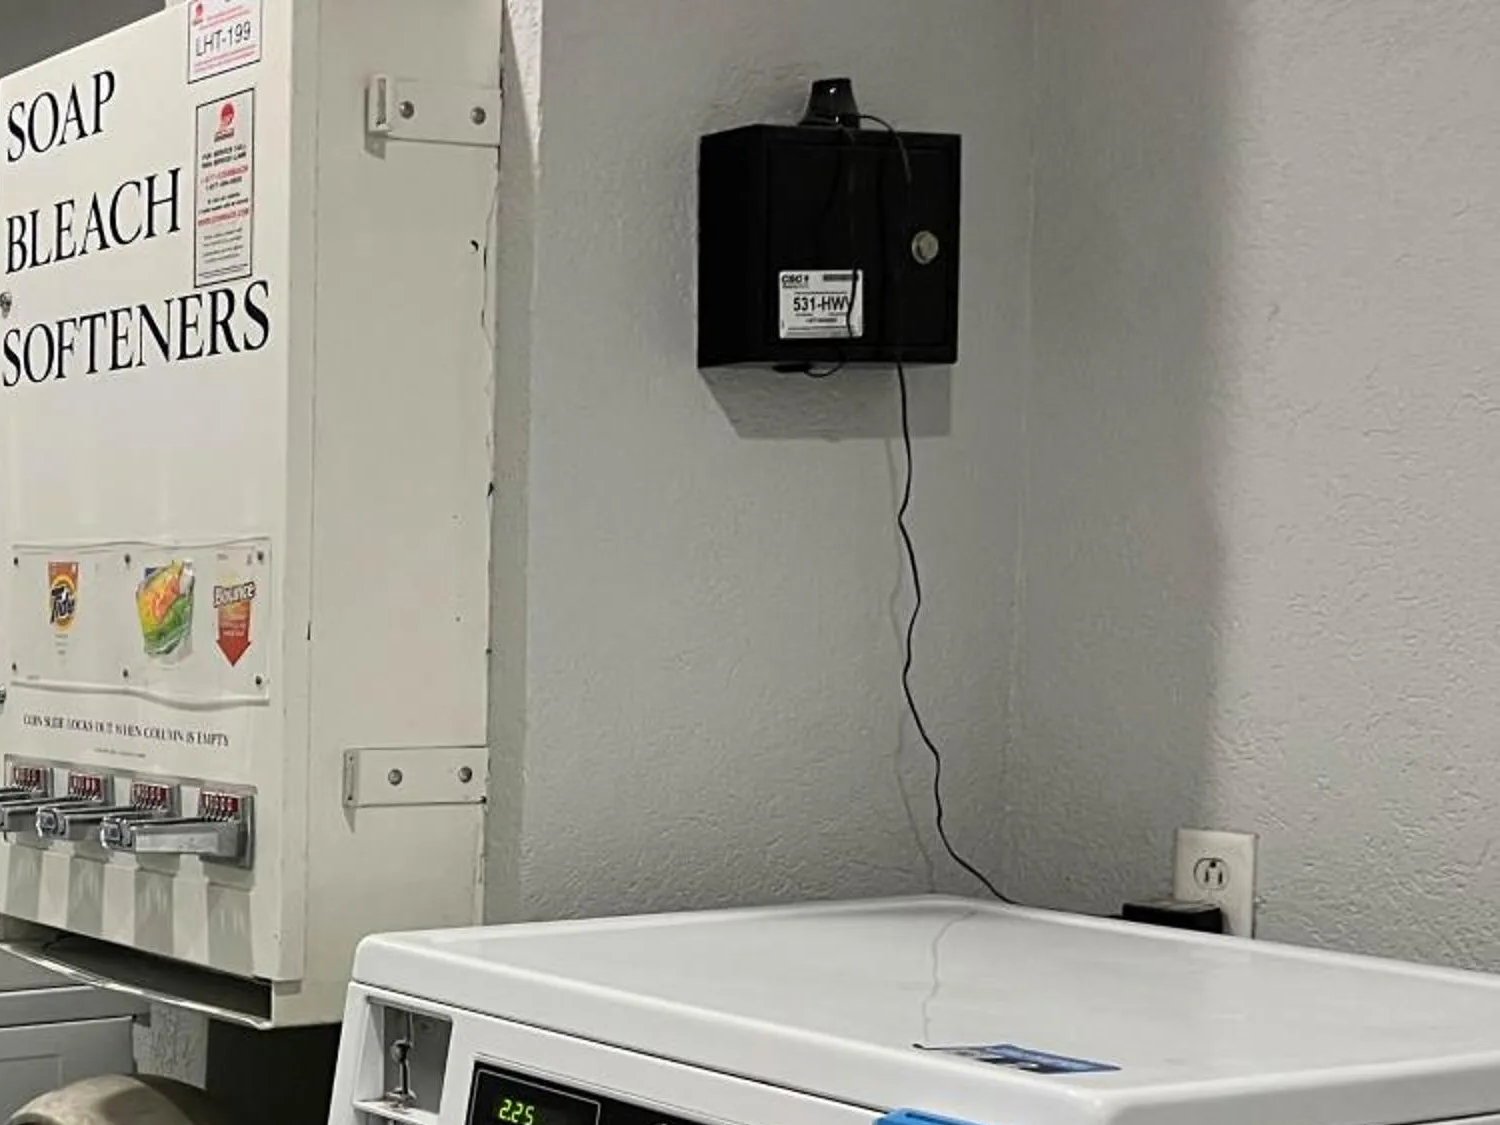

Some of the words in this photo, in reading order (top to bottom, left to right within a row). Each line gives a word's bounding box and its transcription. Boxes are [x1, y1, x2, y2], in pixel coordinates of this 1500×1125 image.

[195, 20, 251, 56] LHT-199
[7, 70, 115, 163] SOAP
[5, 167, 181, 275] BLEACH
[2, 279, 270, 388] SOFTENERS
[114, 723, 142, 737] WHEN
[143, 727, 184, 742] COLUMN
[197, 731, 229, 747] EMPTY
